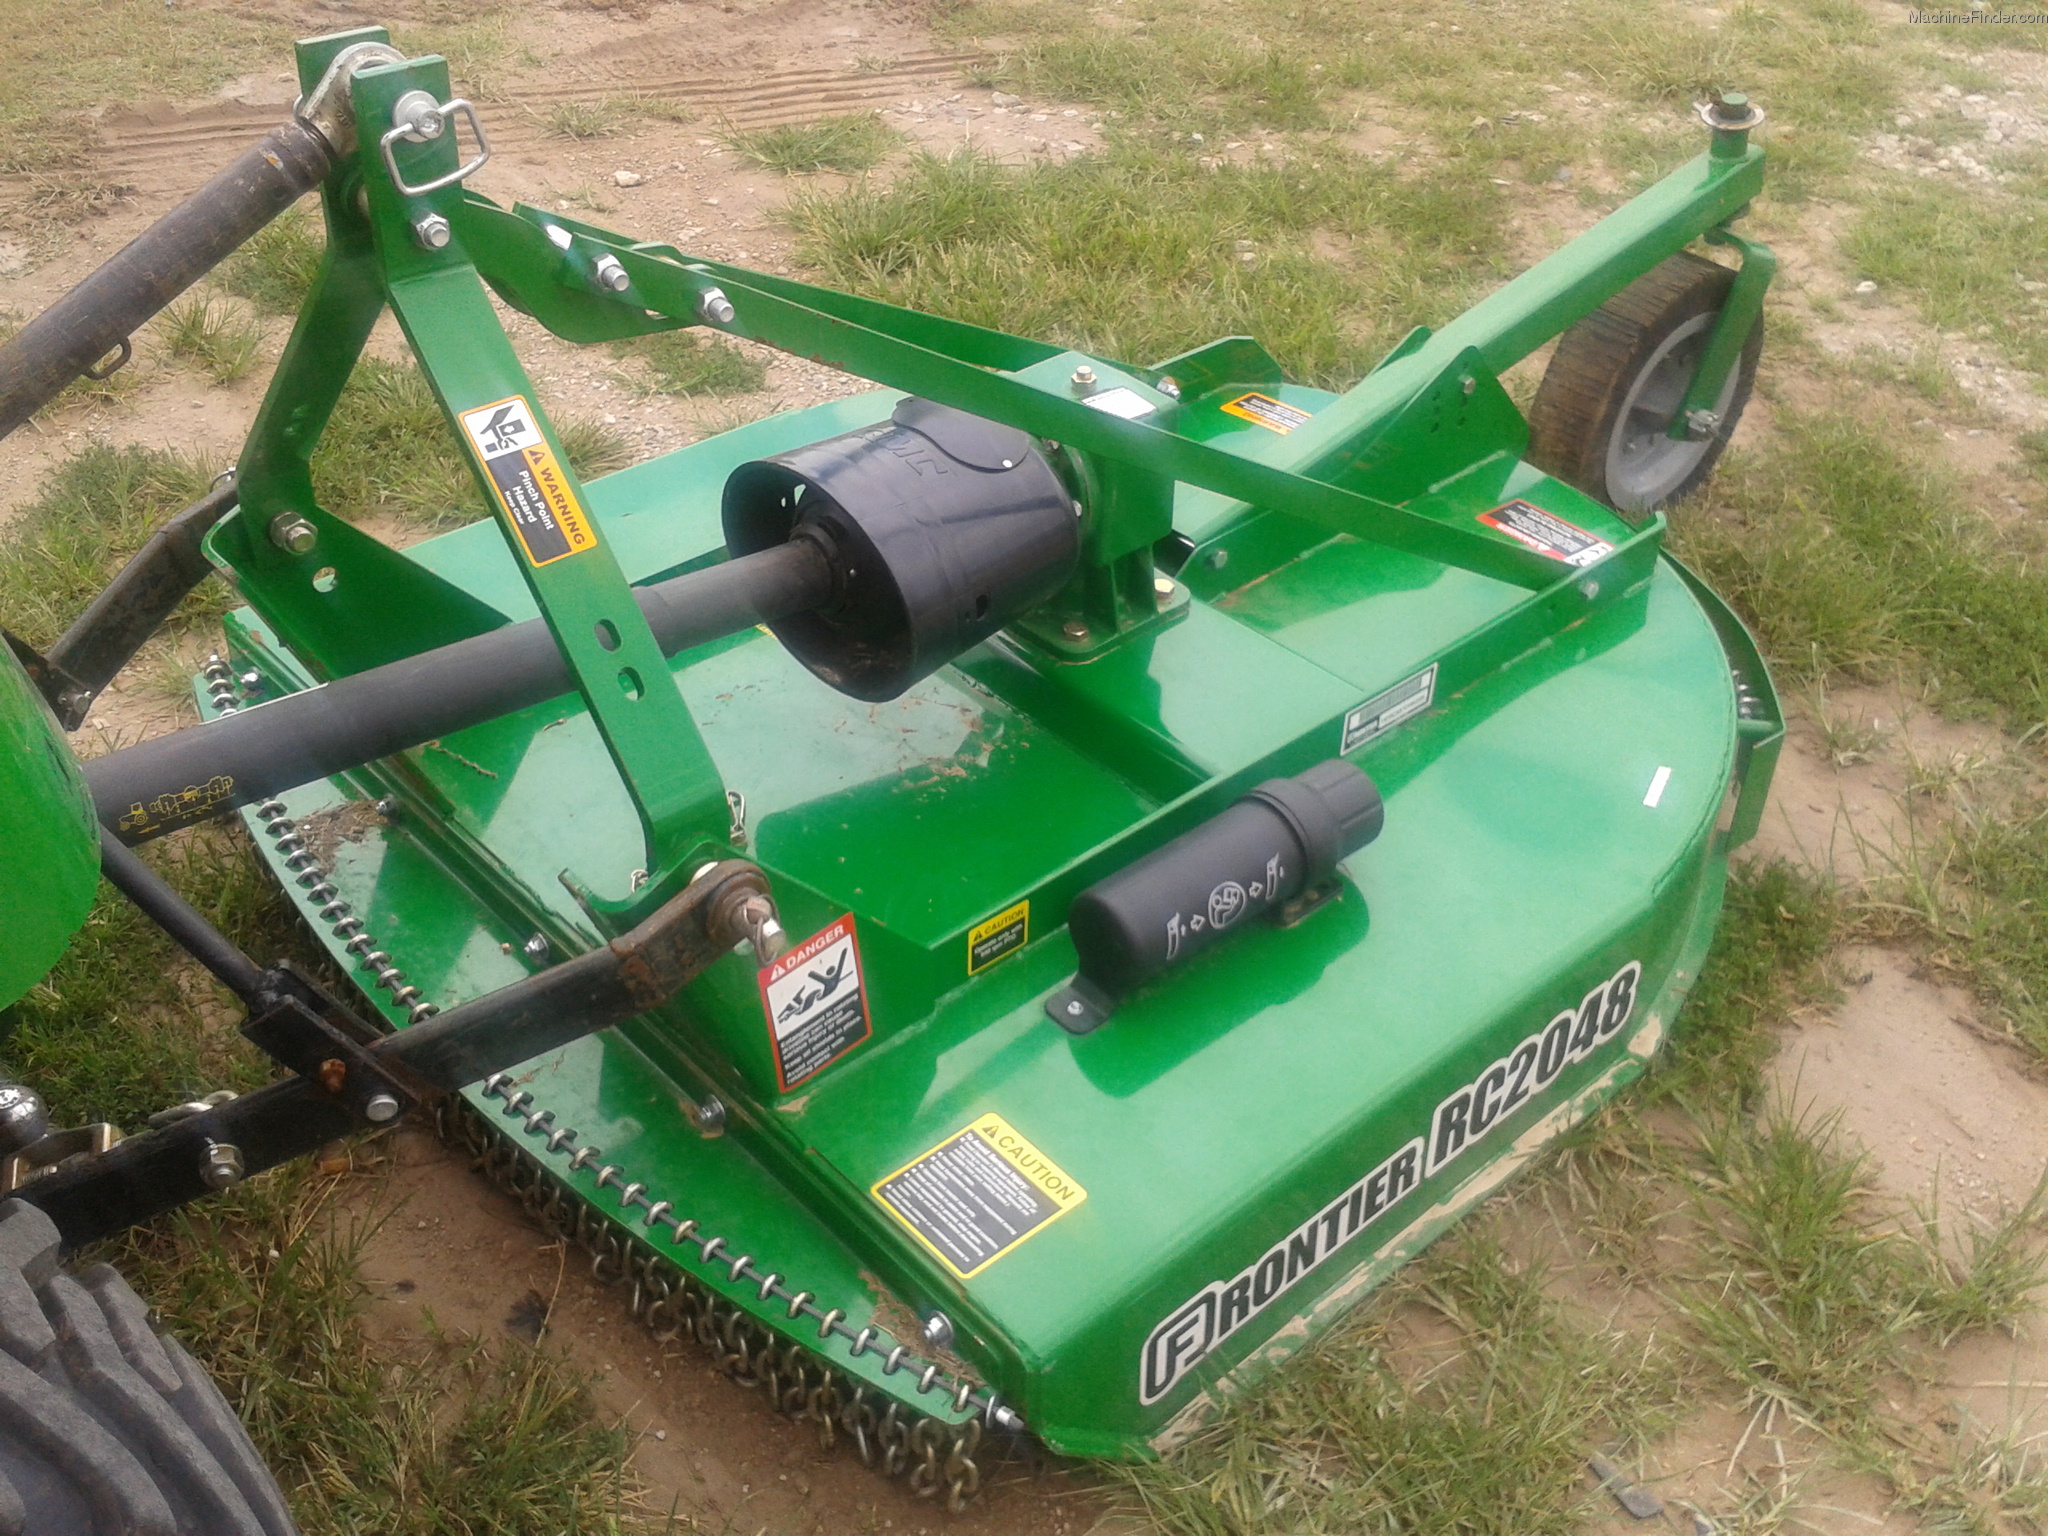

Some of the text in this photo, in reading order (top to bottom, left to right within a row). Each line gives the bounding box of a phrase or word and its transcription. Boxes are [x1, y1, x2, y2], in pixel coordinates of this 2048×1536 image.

[504, 490, 524, 525] Keep Clear
[512, 486, 537, 524] Hazard
[518, 470, 554, 530] Pinch Point
[541, 467, 585, 545] WARNING
[785, 924, 844, 972] DANGER
[984, 908, 1024, 934] CAUTION
[998, 1135, 1075, 1201] CAUTION
[1141, 960, 1641, 1405] FRONTIER RC2048
